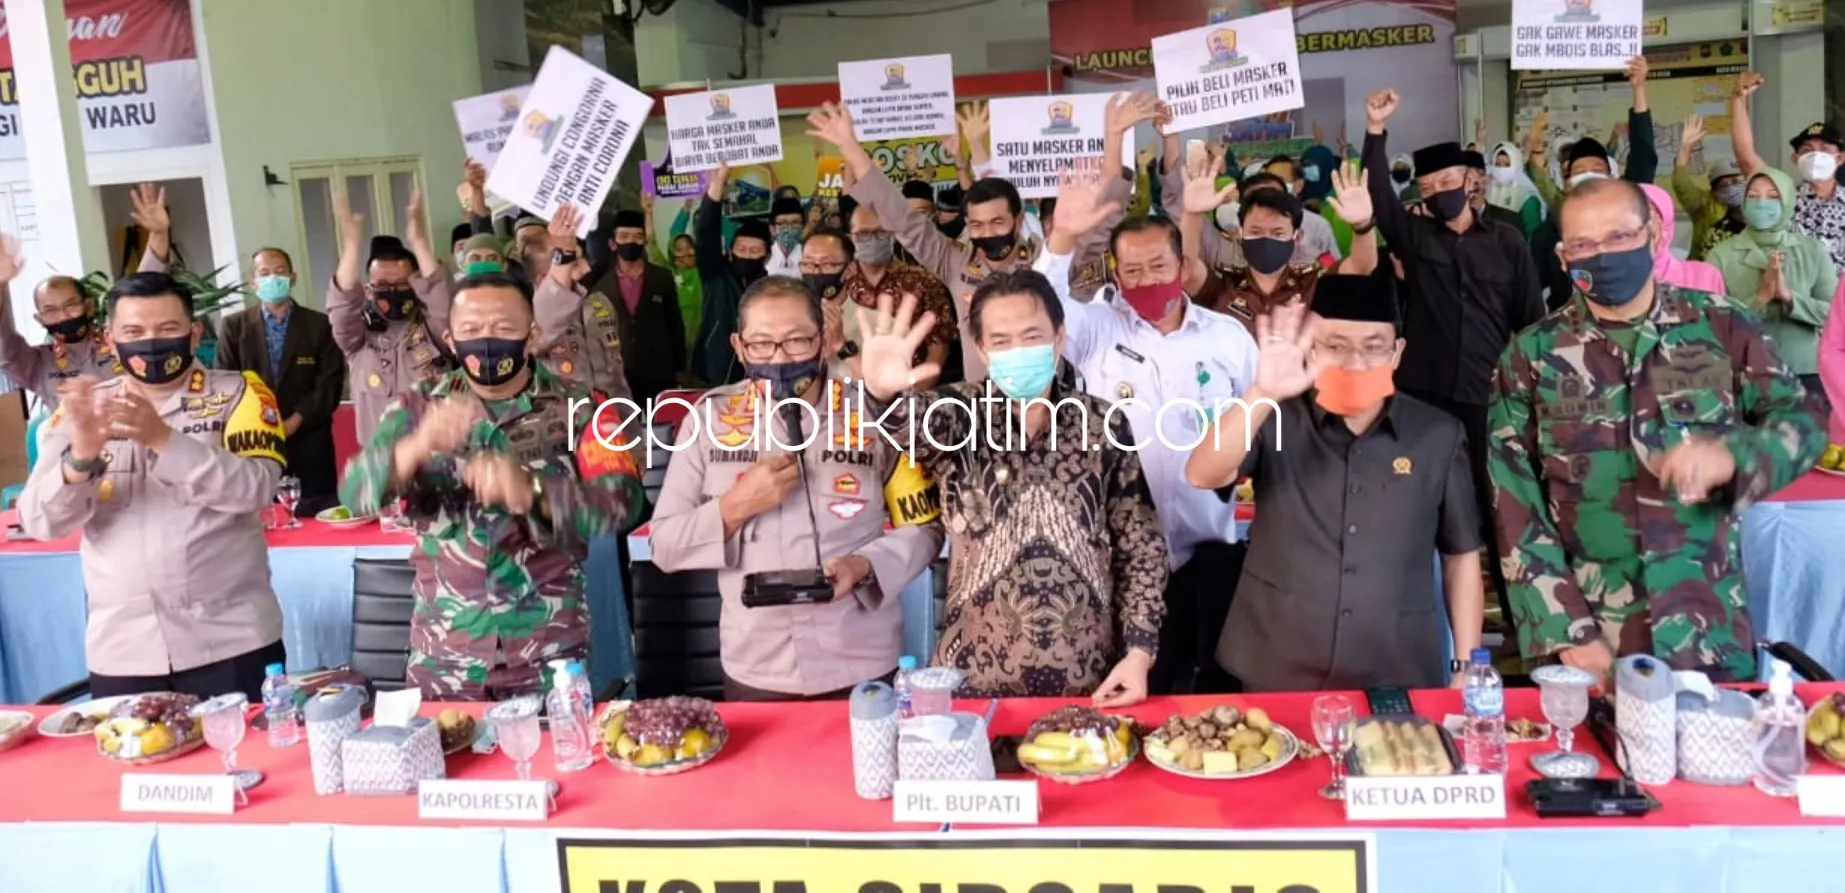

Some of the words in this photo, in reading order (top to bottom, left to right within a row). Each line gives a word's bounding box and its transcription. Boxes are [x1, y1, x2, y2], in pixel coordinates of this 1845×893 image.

[1516, 25, 1541, 40] GAK
[1546, 25, 1580, 40] GAWE
[1586, 24, 1638, 39] MASKER
[1075, 46, 1153, 71] LAUNC
[1516, 43, 1541, 57] GAK
[1545, 42, 1586, 57] MBOIS
[1166, 81, 1200, 100] PILIH
[1203, 73, 1230, 92] BELI
[1233, 61, 1288, 86] MASKER
[1201, 92, 1229, 112] BELI
[1231, 87, 1260, 106] PETI
[86, 102, 156, 129] WARU
[581, 99, 619, 154] MASKER
[706, 120, 747, 136] MASKER
[996, 142, 1029, 157] SATU
[1032, 139, 1085, 155] MASKER
[1087, 138, 1104, 152] AN
[576, 173, 603, 207] ANTI
[592, 119, 631, 175] CORONA
[821, 450, 873, 467] POLRI
[137, 783, 214, 803] DANDIM
[422, 791, 538, 811] KAPOLRESTA
[906, 793, 940, 813] Plt.
[946, 794, 1022, 814] BUPATI
[1351, 786, 1430, 806] KETUA
[1433, 784, 1496, 805] DPRD
